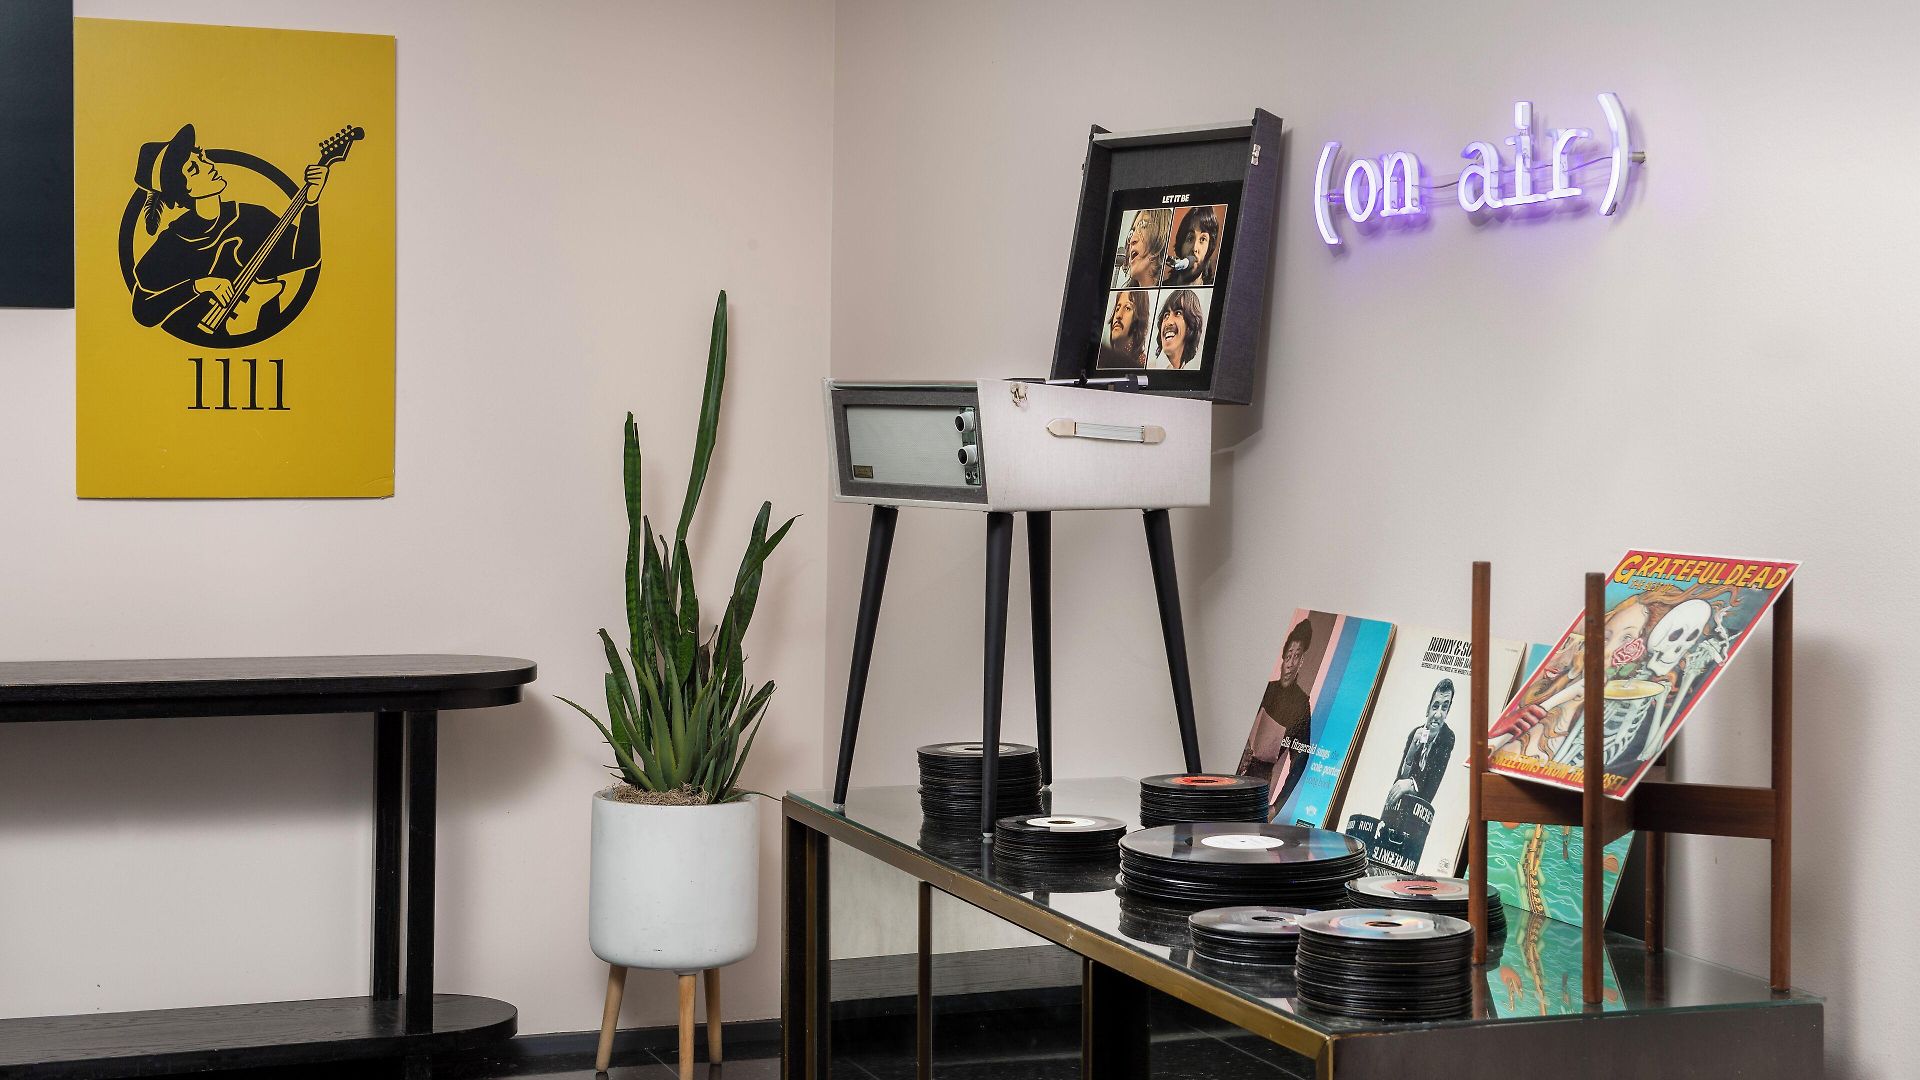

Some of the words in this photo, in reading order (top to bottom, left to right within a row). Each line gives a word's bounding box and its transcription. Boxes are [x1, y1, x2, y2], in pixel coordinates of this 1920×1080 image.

[1162, 195, 1174, 203] LET
[1181, 193, 1190, 202] BE
[1613, 554, 1727, 585] GRATEFUL
[1724, 564, 1788, 590] DEAD
[1453, 640, 1463, 656] &
[1460, 641, 1472, 657] SO
[1358, 820, 1374, 832] RICH
